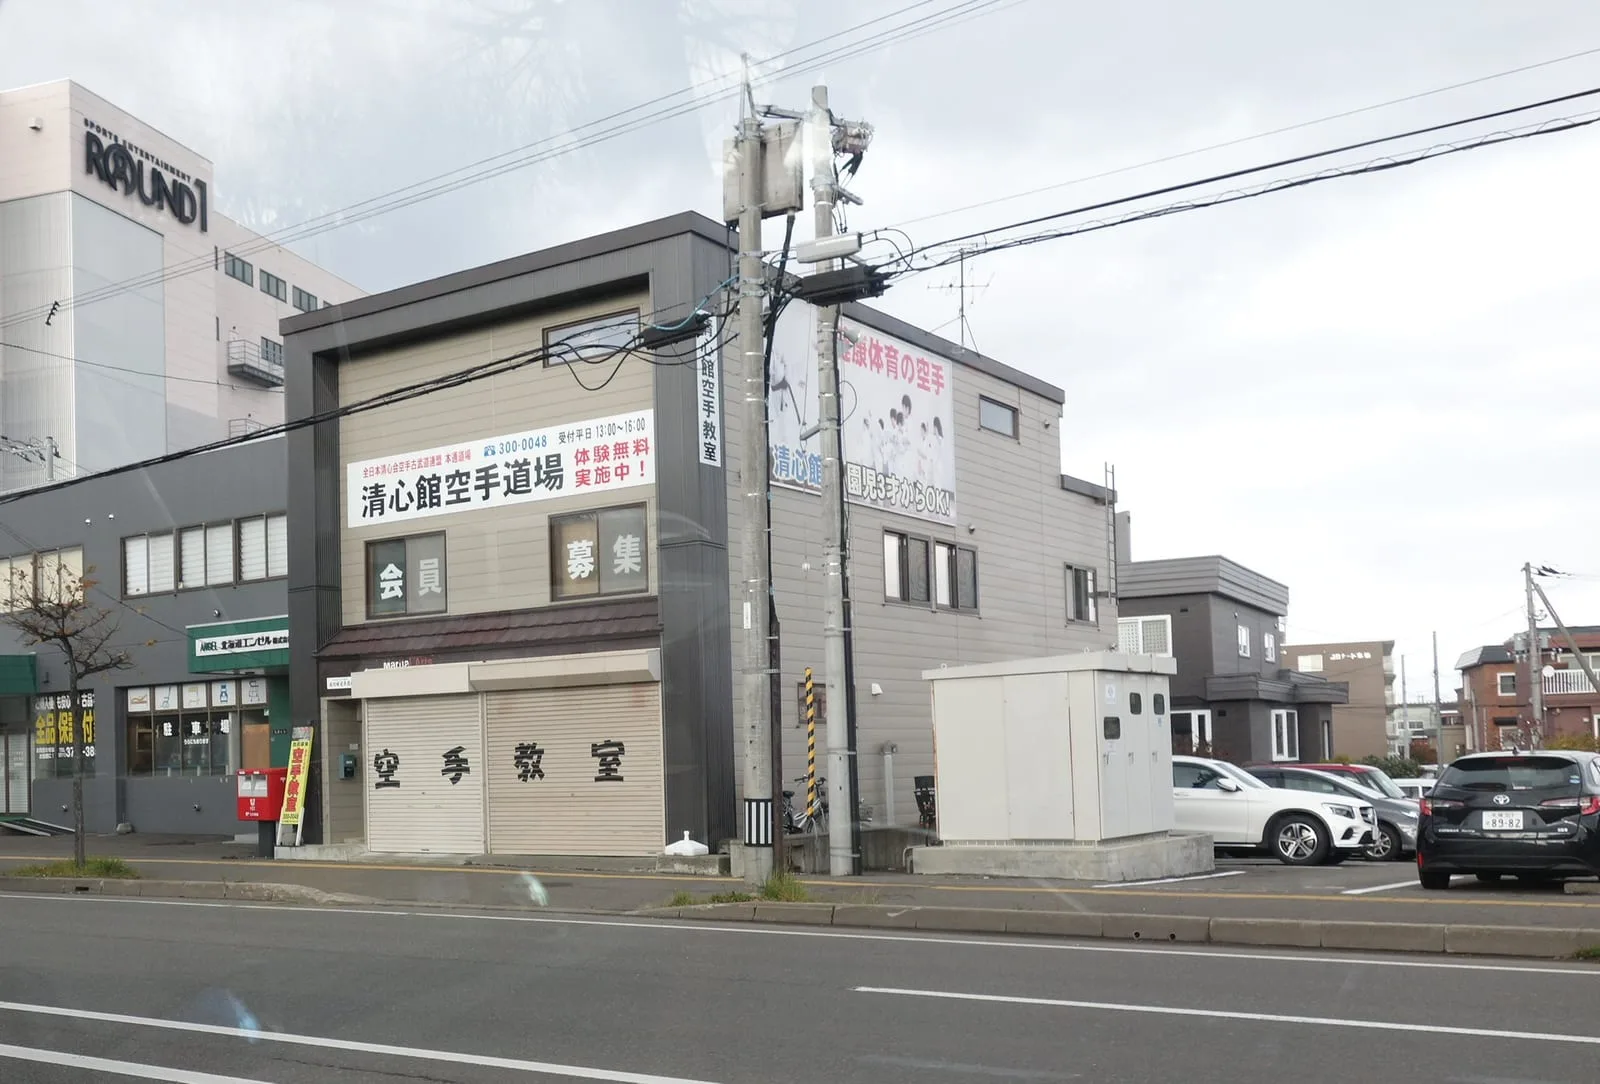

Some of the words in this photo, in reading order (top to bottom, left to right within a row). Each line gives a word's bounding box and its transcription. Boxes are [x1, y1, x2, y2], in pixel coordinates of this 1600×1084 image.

[84, 118, 119, 144] SPORTS
[122, 140, 191, 182] ENTERTAINMENT
[86, 131, 207, 232] ROUND1
[558, 428, 592, 445] 受付平日
[574, 437, 649, 466] 体験無料
[361, 453, 564, 518] 清心館空手道場
[379, 557, 442, 601] 会員
[566, 533, 642, 580] 募集
[373, 739, 625, 789] 空手教室
[1491, 818, 1521, 828] 89-82
